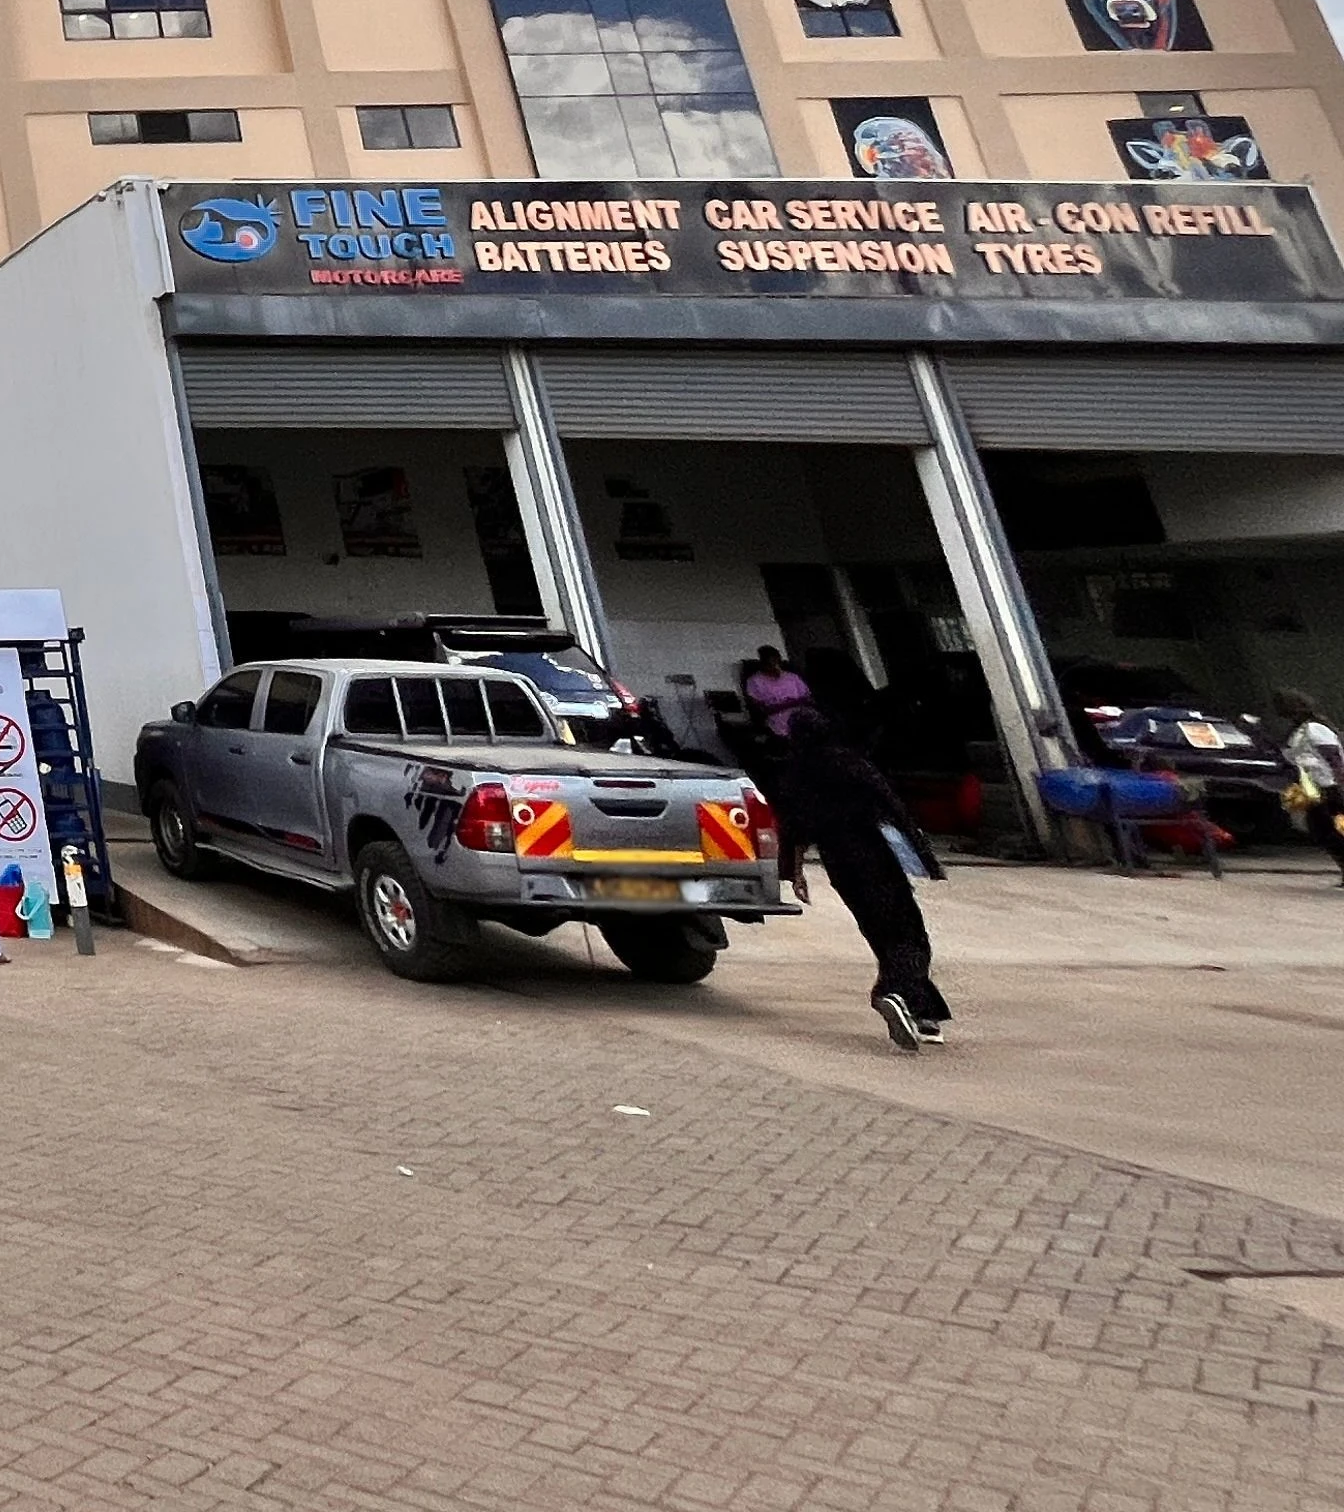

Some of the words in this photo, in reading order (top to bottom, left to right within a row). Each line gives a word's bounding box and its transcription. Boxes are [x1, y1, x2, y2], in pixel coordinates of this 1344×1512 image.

[291, 188, 449, 231] FINE
[470, 199, 681, 232] ALIGNMENT
[704, 198, 780, 233] CAR
[789, 199, 945, 234] SERVICE
[1142, 204, 1276, 238] REFILL
[297, 232, 456, 261] TOUCH
[475, 240, 672, 273] BATTERIES
[717, 239, 955, 276] SUSPENSION
[974, 241, 1104, 276] TYRES
[310, 267, 465, 286] MOTORCARE
